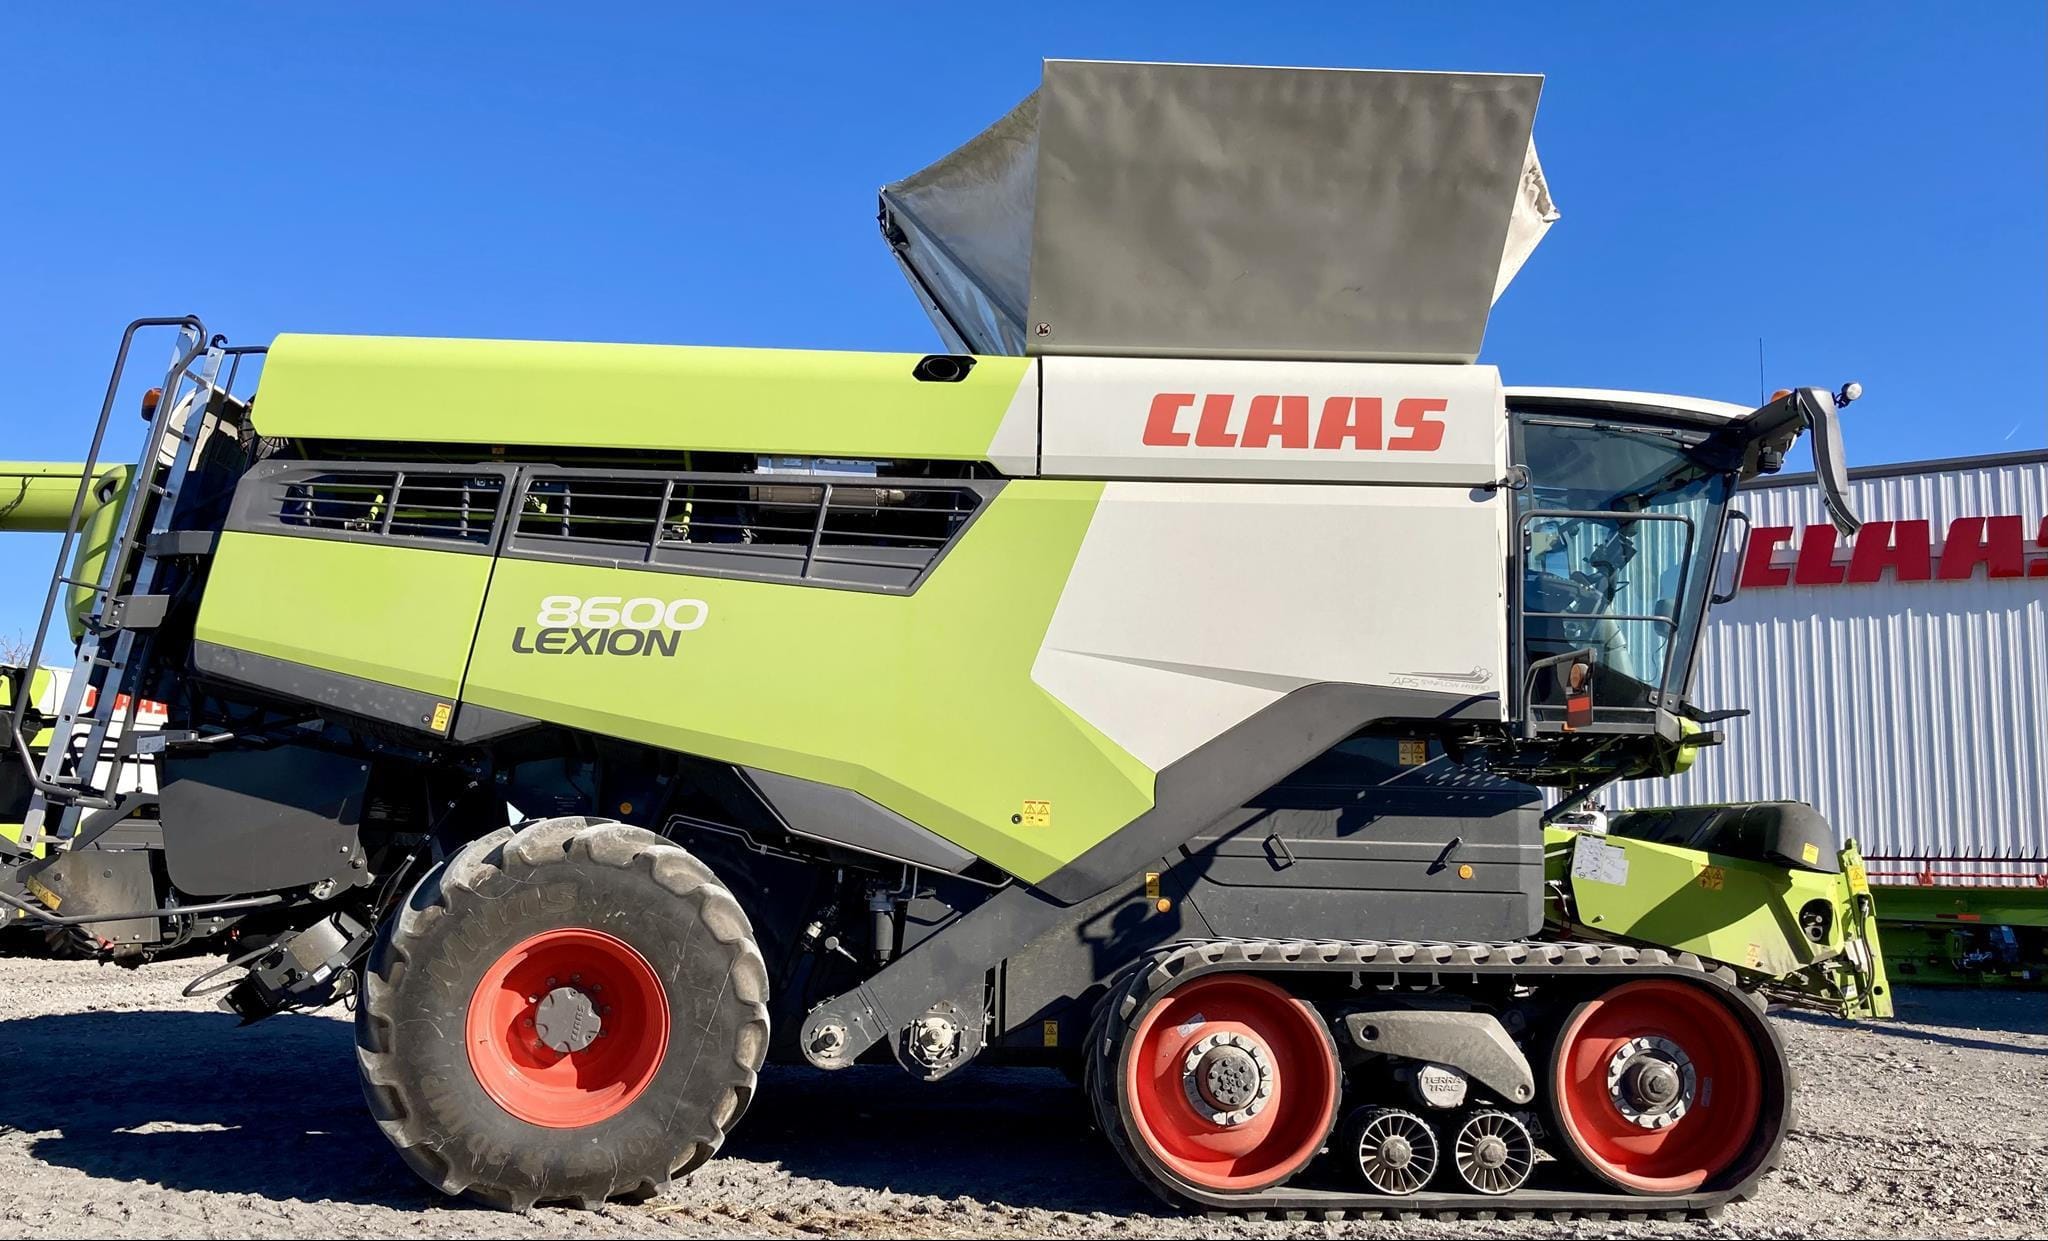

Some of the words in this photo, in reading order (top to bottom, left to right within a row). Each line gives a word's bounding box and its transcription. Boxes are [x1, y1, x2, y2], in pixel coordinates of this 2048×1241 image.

[1142, 393, 1448, 452] CLAAS
[536, 595, 709, 631] 8600
[511, 627, 682, 657] LEXION
[1391, 676, 1419, 688] APS
[1424, 1076, 1462, 1085] TERRA
[1429, 1084, 1460, 1092] TRAC
